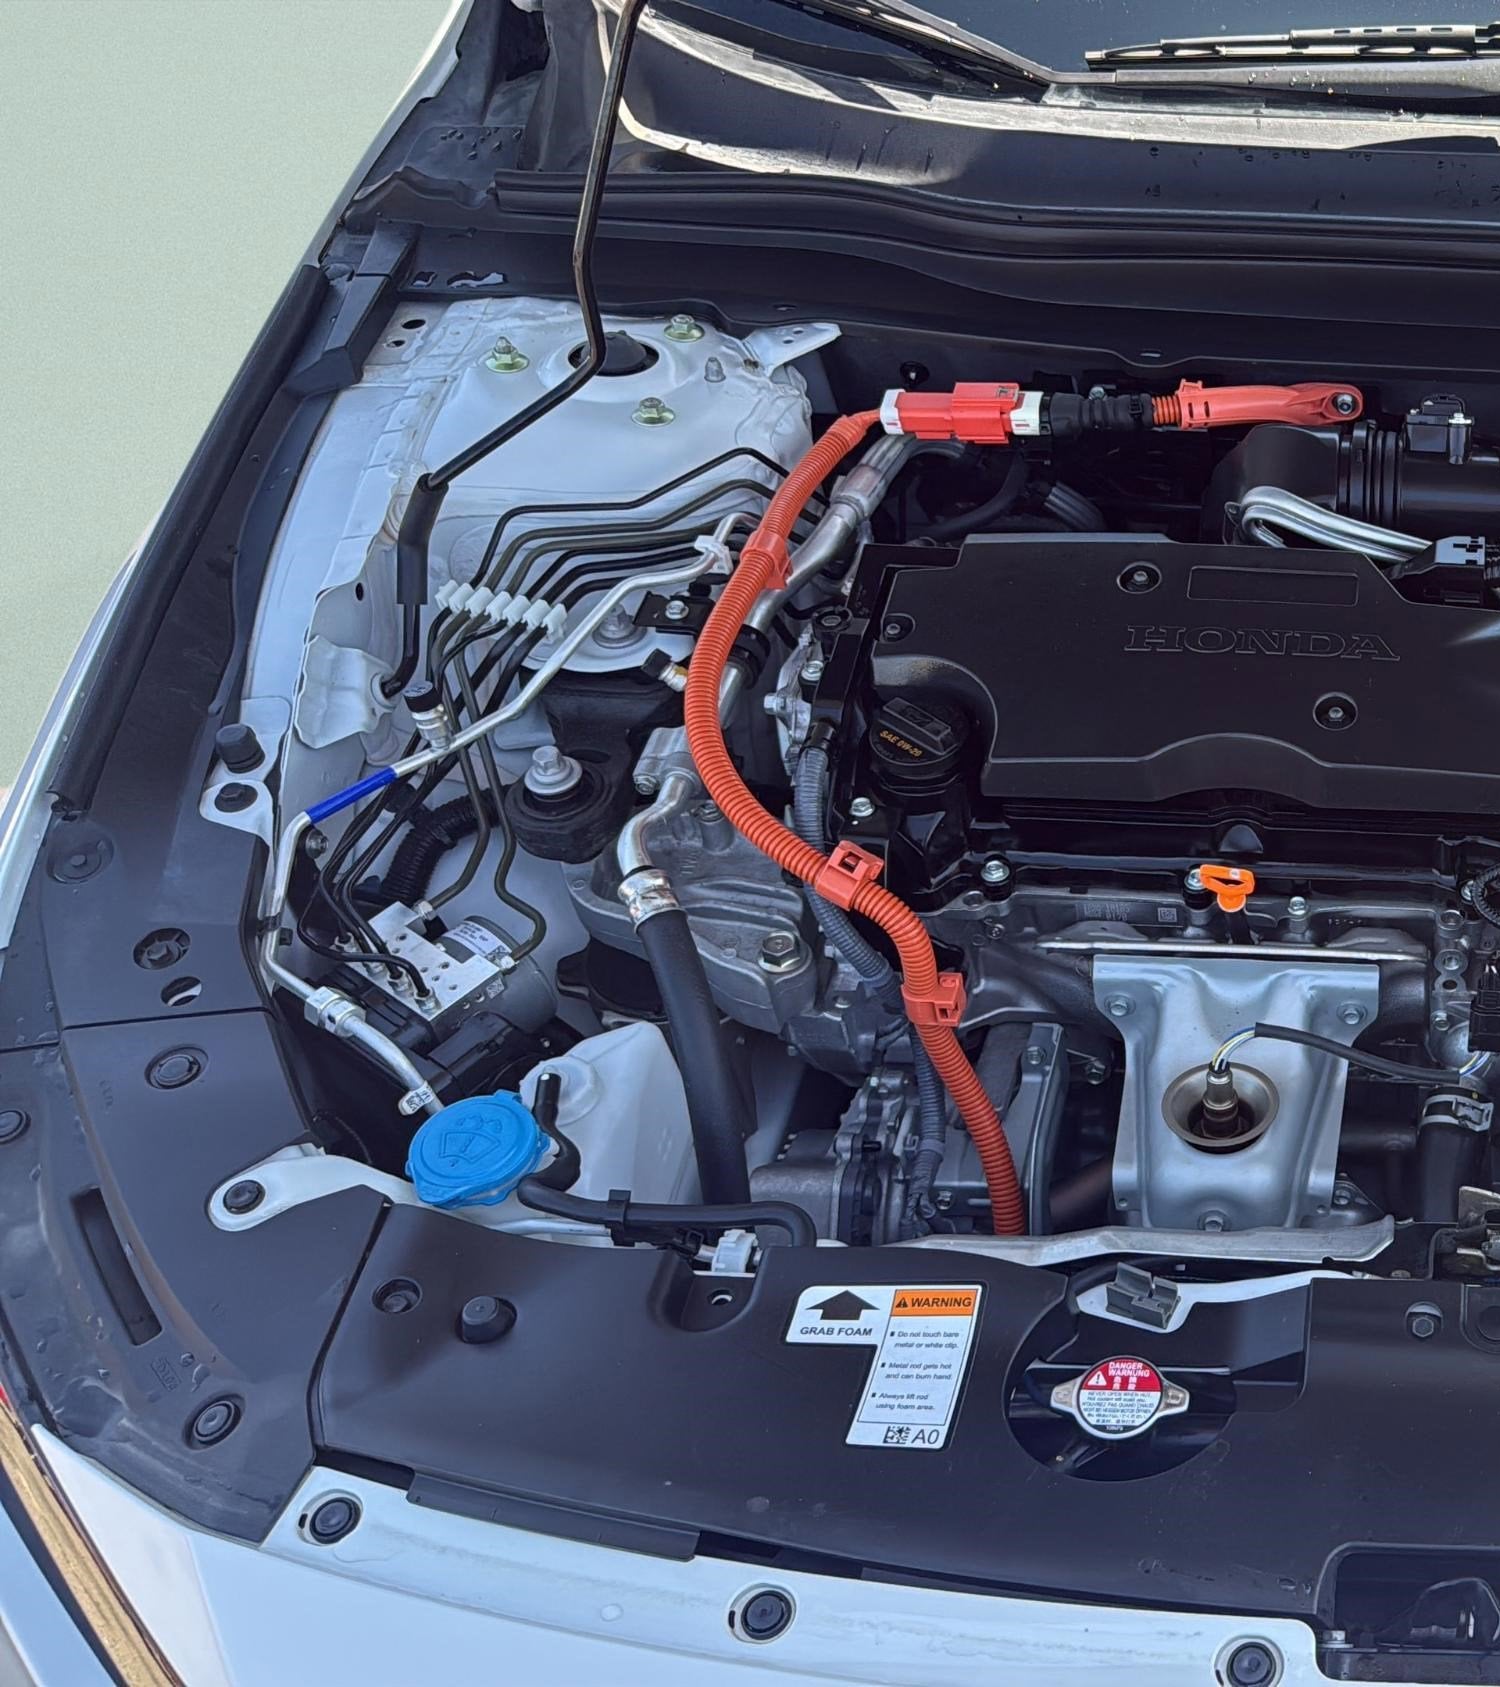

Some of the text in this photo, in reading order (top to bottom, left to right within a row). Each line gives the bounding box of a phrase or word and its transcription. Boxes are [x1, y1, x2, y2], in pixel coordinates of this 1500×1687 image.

[1124, 625, 1401, 661] HONDA
[880, 730, 900, 743] SAE
[911, 1297, 972, 1308] WARNING
[800, 1326, 873, 1337] GRAB FOAM
[1109, 1362, 1143, 1370] DANGER
[1108, 1369, 1150, 1377] WARNUNG
[879, 1392, 905, 1400] Always
[911, 1428, 940, 1445] A0
